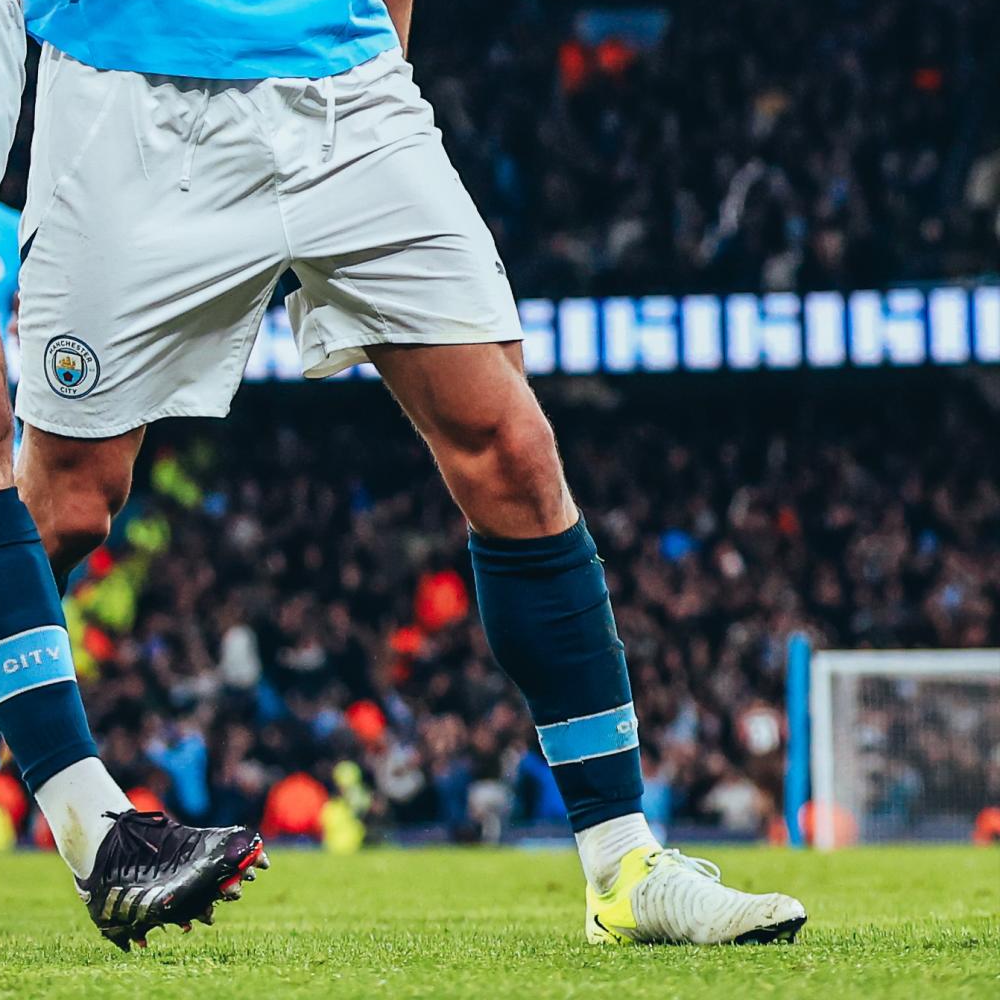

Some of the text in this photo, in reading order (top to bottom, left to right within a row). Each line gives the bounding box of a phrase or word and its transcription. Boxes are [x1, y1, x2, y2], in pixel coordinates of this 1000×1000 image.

[49, 340, 93, 363] MANCHESTER
[60, 386, 78, 395] CITY
[2, 647, 61, 675] CITY
